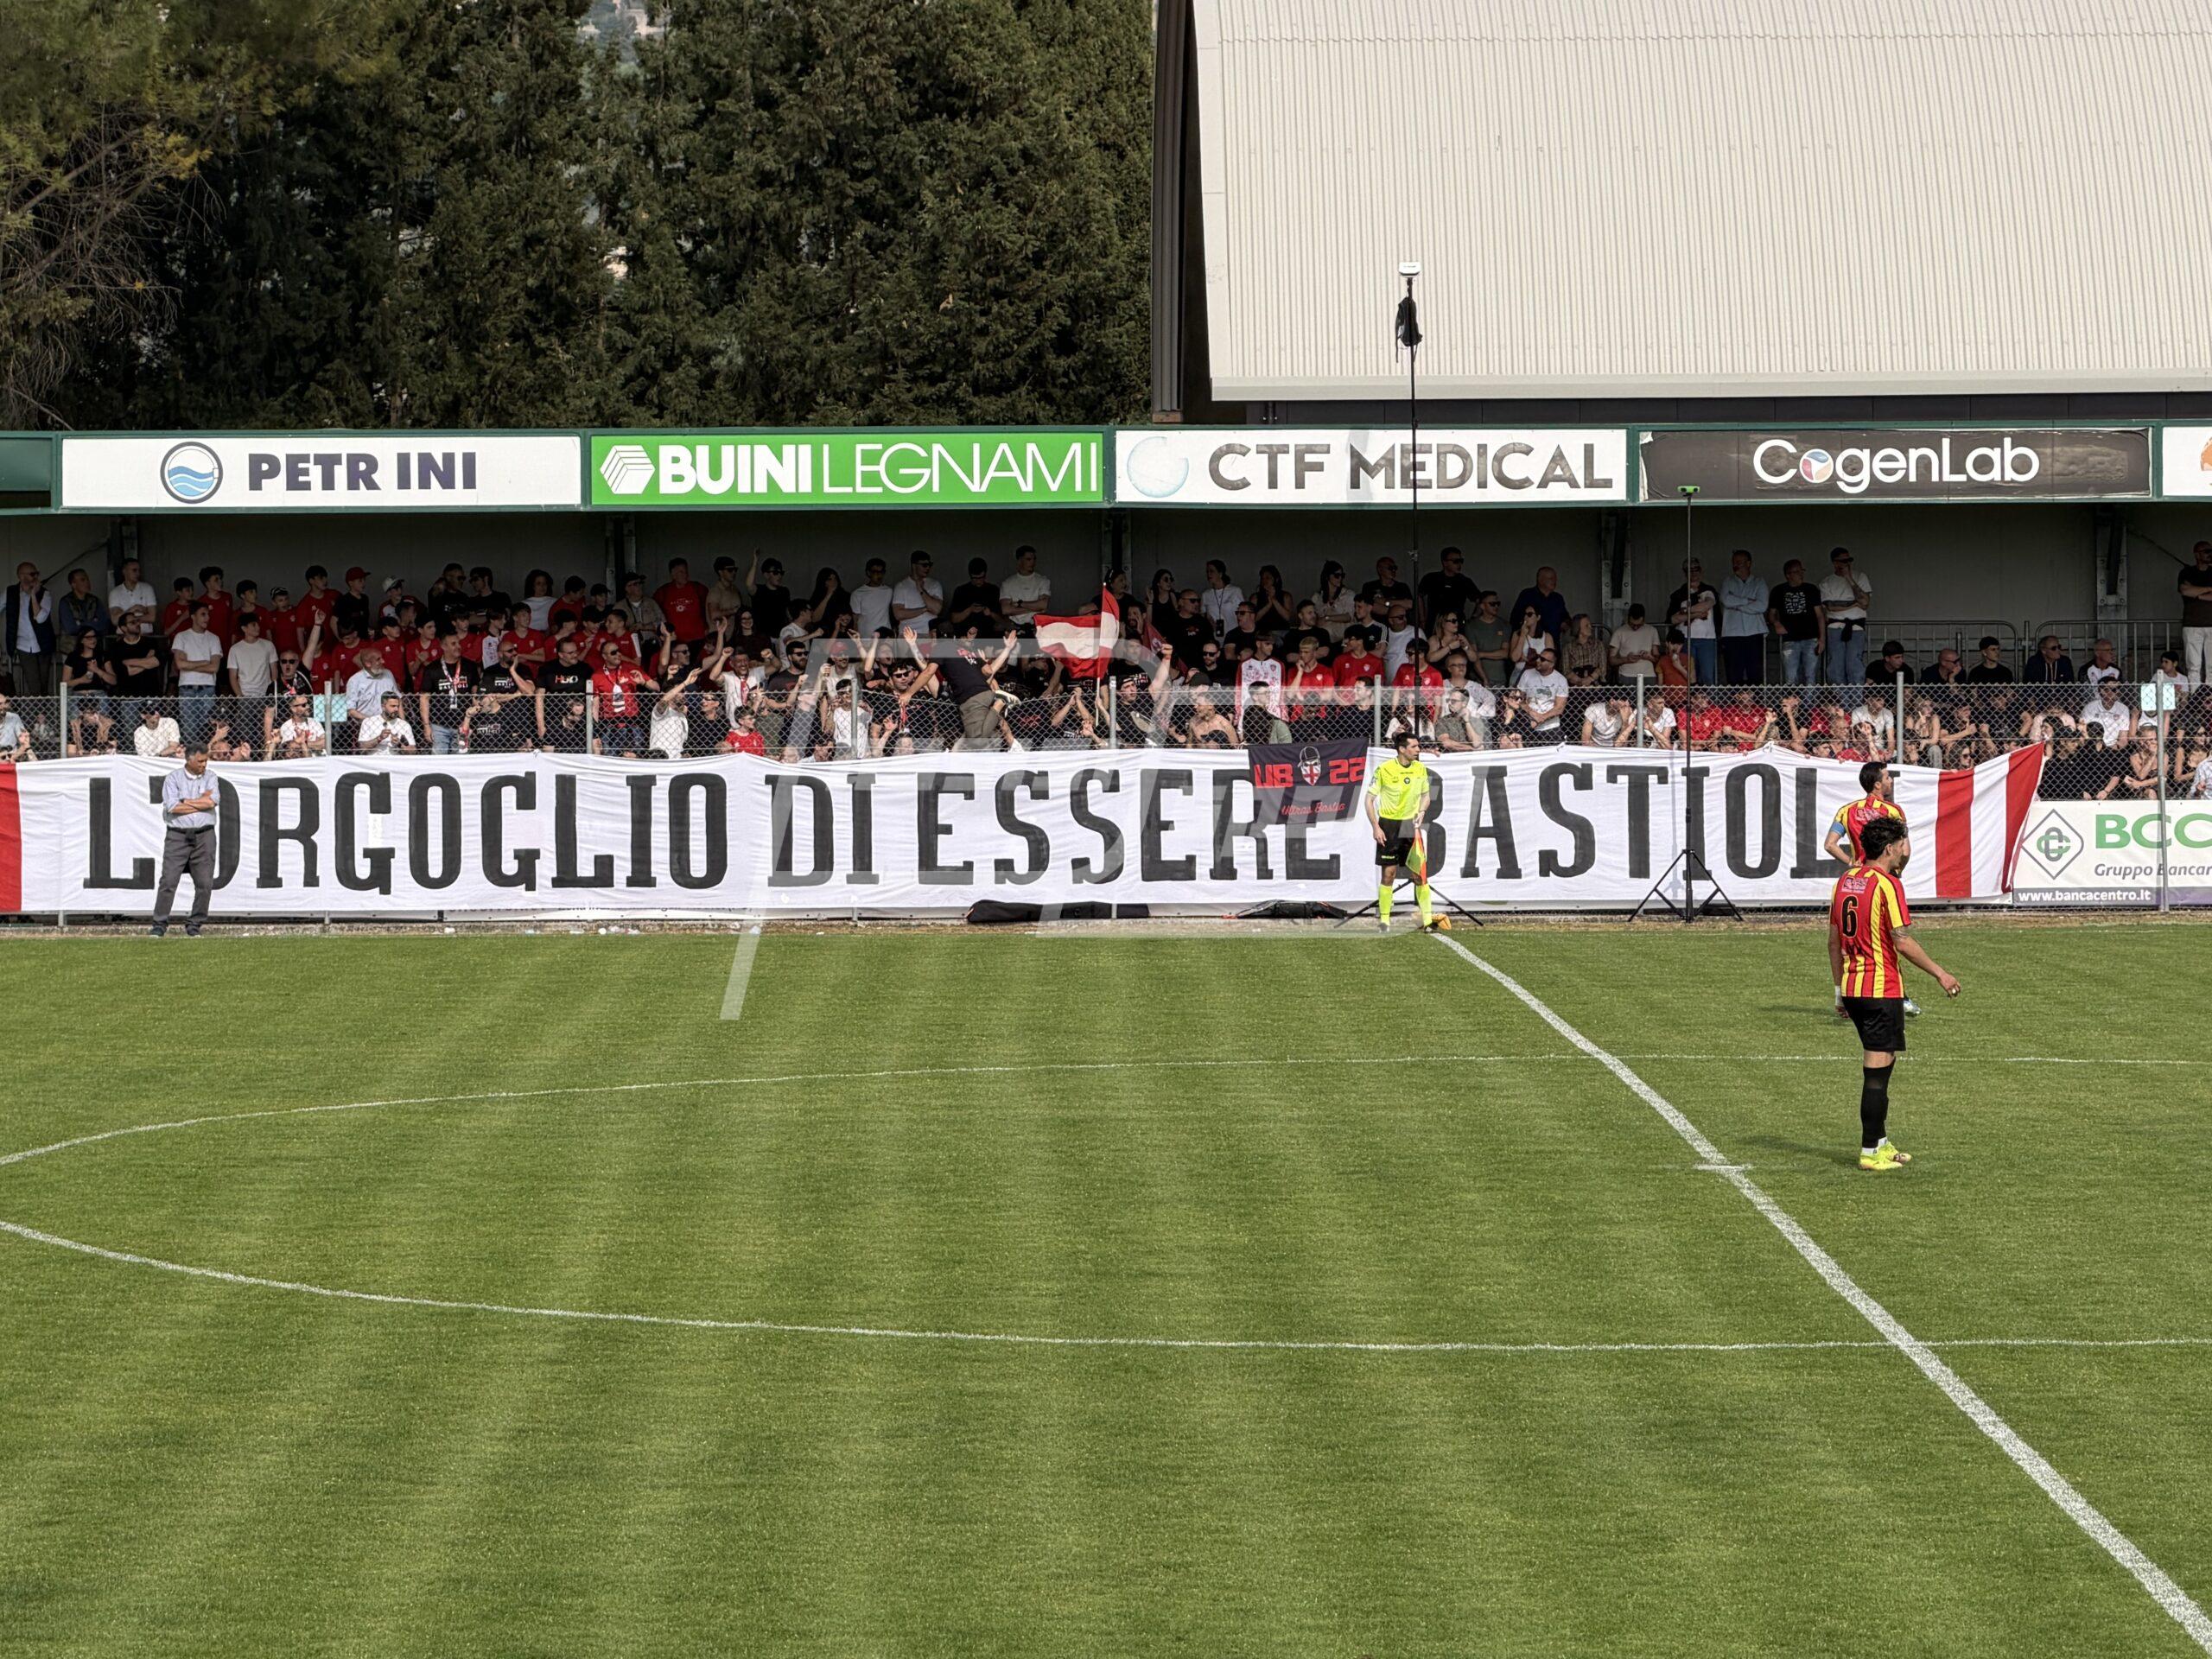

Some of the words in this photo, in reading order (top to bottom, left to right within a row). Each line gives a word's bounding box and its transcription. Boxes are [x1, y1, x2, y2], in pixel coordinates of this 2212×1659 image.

[658, 444, 812, 495] BUINI
[823, 442, 1098, 494] LEGNAMI
[1208, 443, 1332, 491] CTF
[1349, 443, 1614, 490] MEDICAL
[1752, 437, 2041, 495] CogenLab
[1253, 762, 1294, 788] UB
[1328, 757, 1367, 785] 22
[764, 773, 880, 887] DI
[1394, 762, 1901, 881] ASTIOL
[2094, 863, 2154, 880] Gruppo
[1841, 894, 1859, 938] 6
[2018, 888, 2152, 902] www.bancacentro.it
